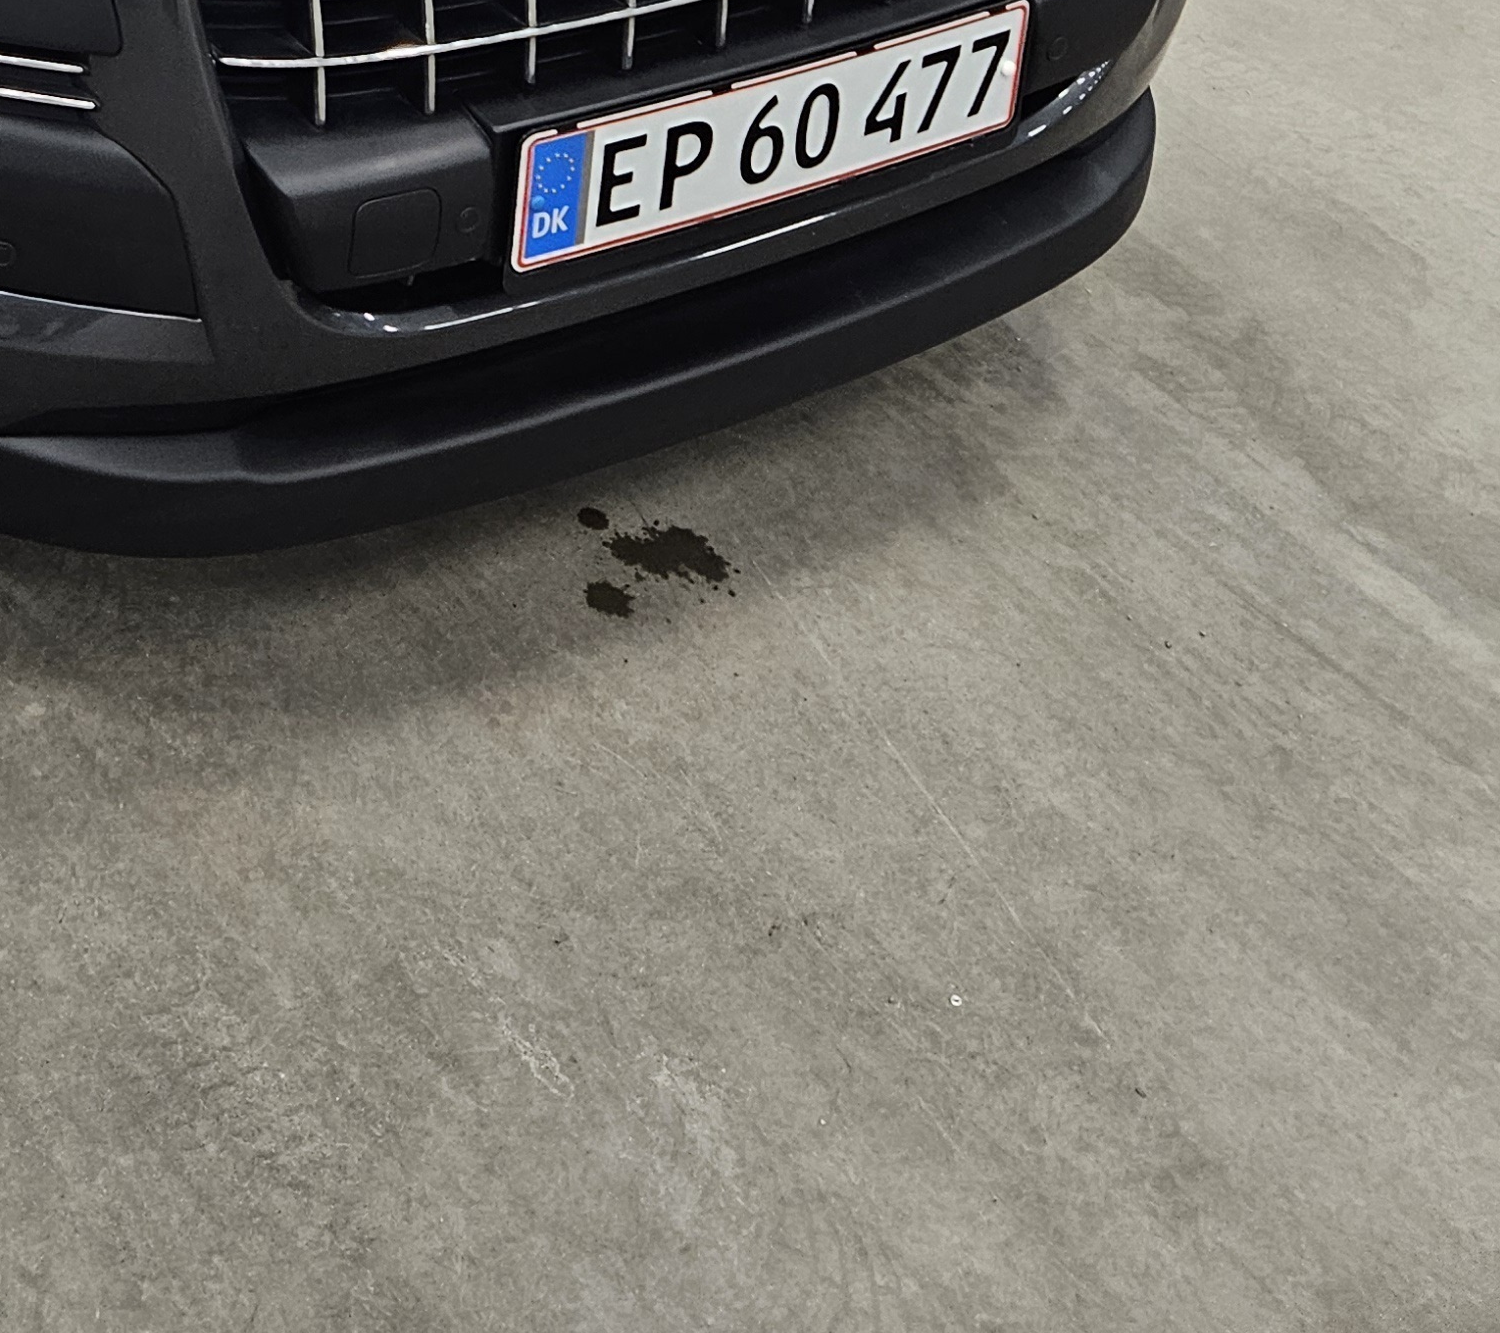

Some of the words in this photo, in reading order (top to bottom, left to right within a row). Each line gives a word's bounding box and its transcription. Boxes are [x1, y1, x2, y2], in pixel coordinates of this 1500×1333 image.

[595, 120, 714, 228] EP
[739, 82, 841, 185] 60
[863, 29, 1012, 144] 477
[531, 205, 569, 240] DK
